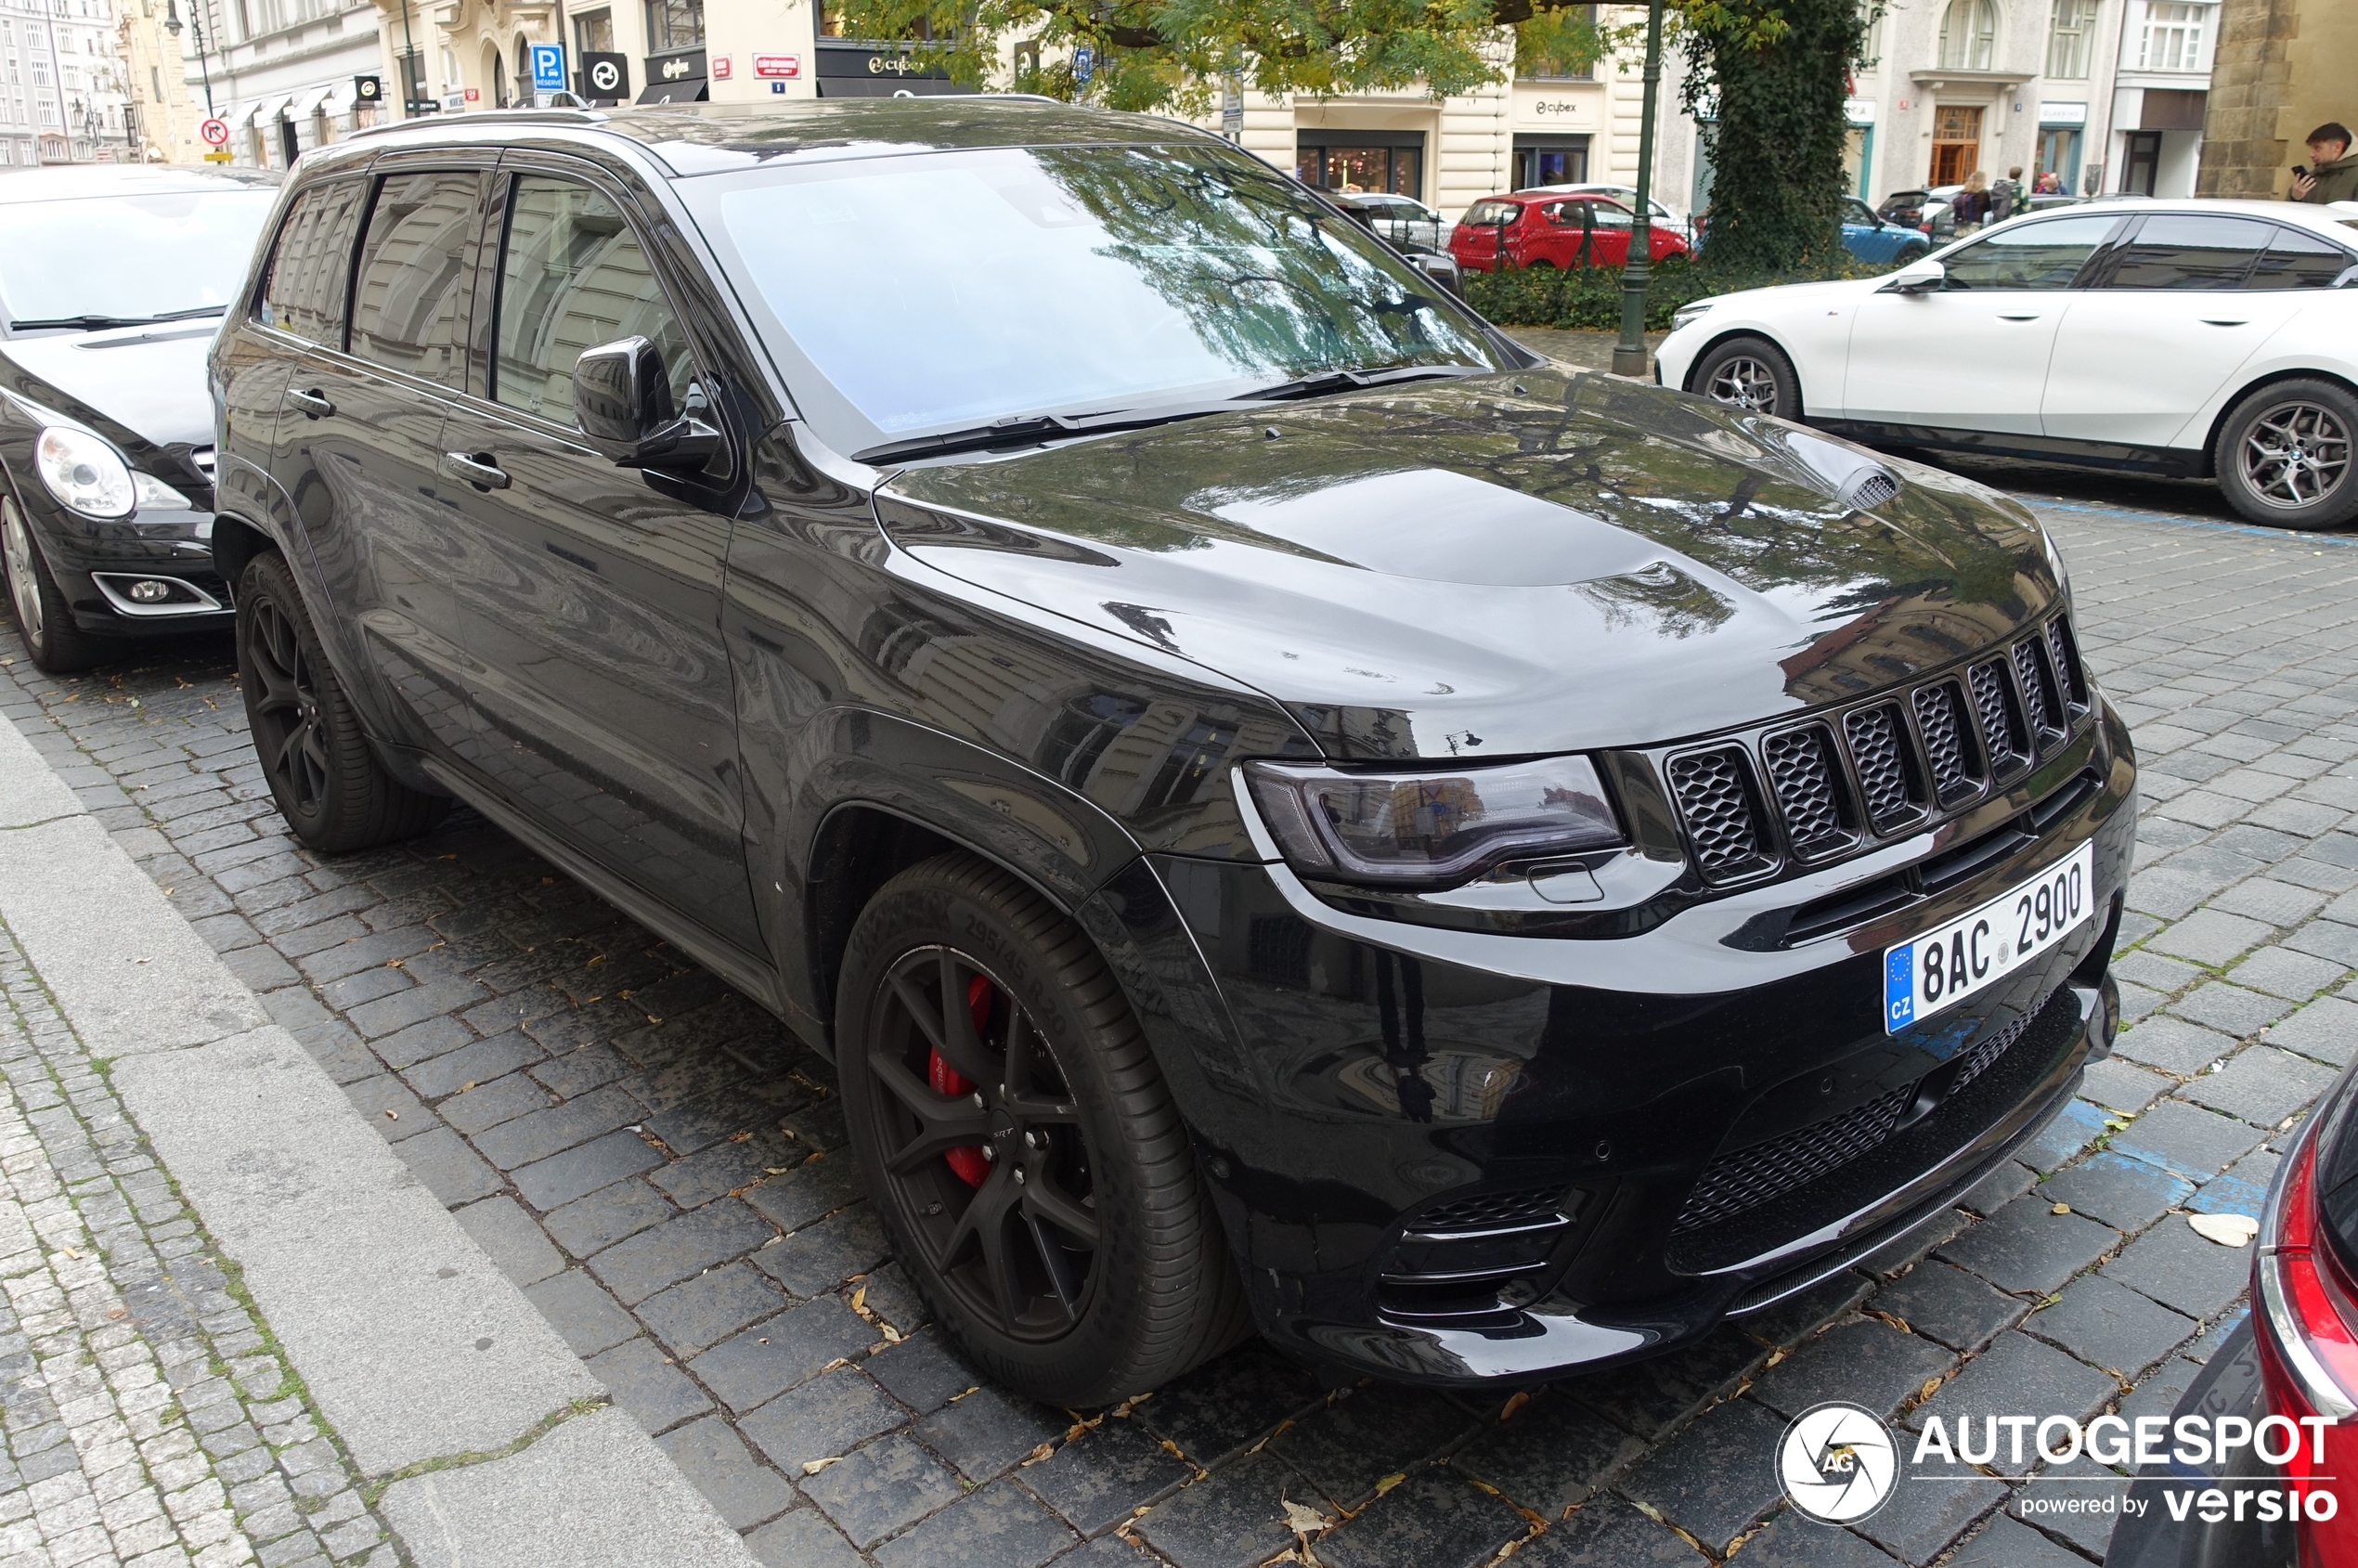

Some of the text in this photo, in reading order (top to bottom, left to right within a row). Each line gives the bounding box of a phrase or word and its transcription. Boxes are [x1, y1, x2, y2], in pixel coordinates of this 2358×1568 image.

[538, 50, 556, 77] P
[1548, 99, 1576, 117] cybex
[1924, 862, 2081, 1003] 8AC 2900
[1891, 998, 1911, 1019] CZ
[993, 1127, 1014, 1138] SRT
